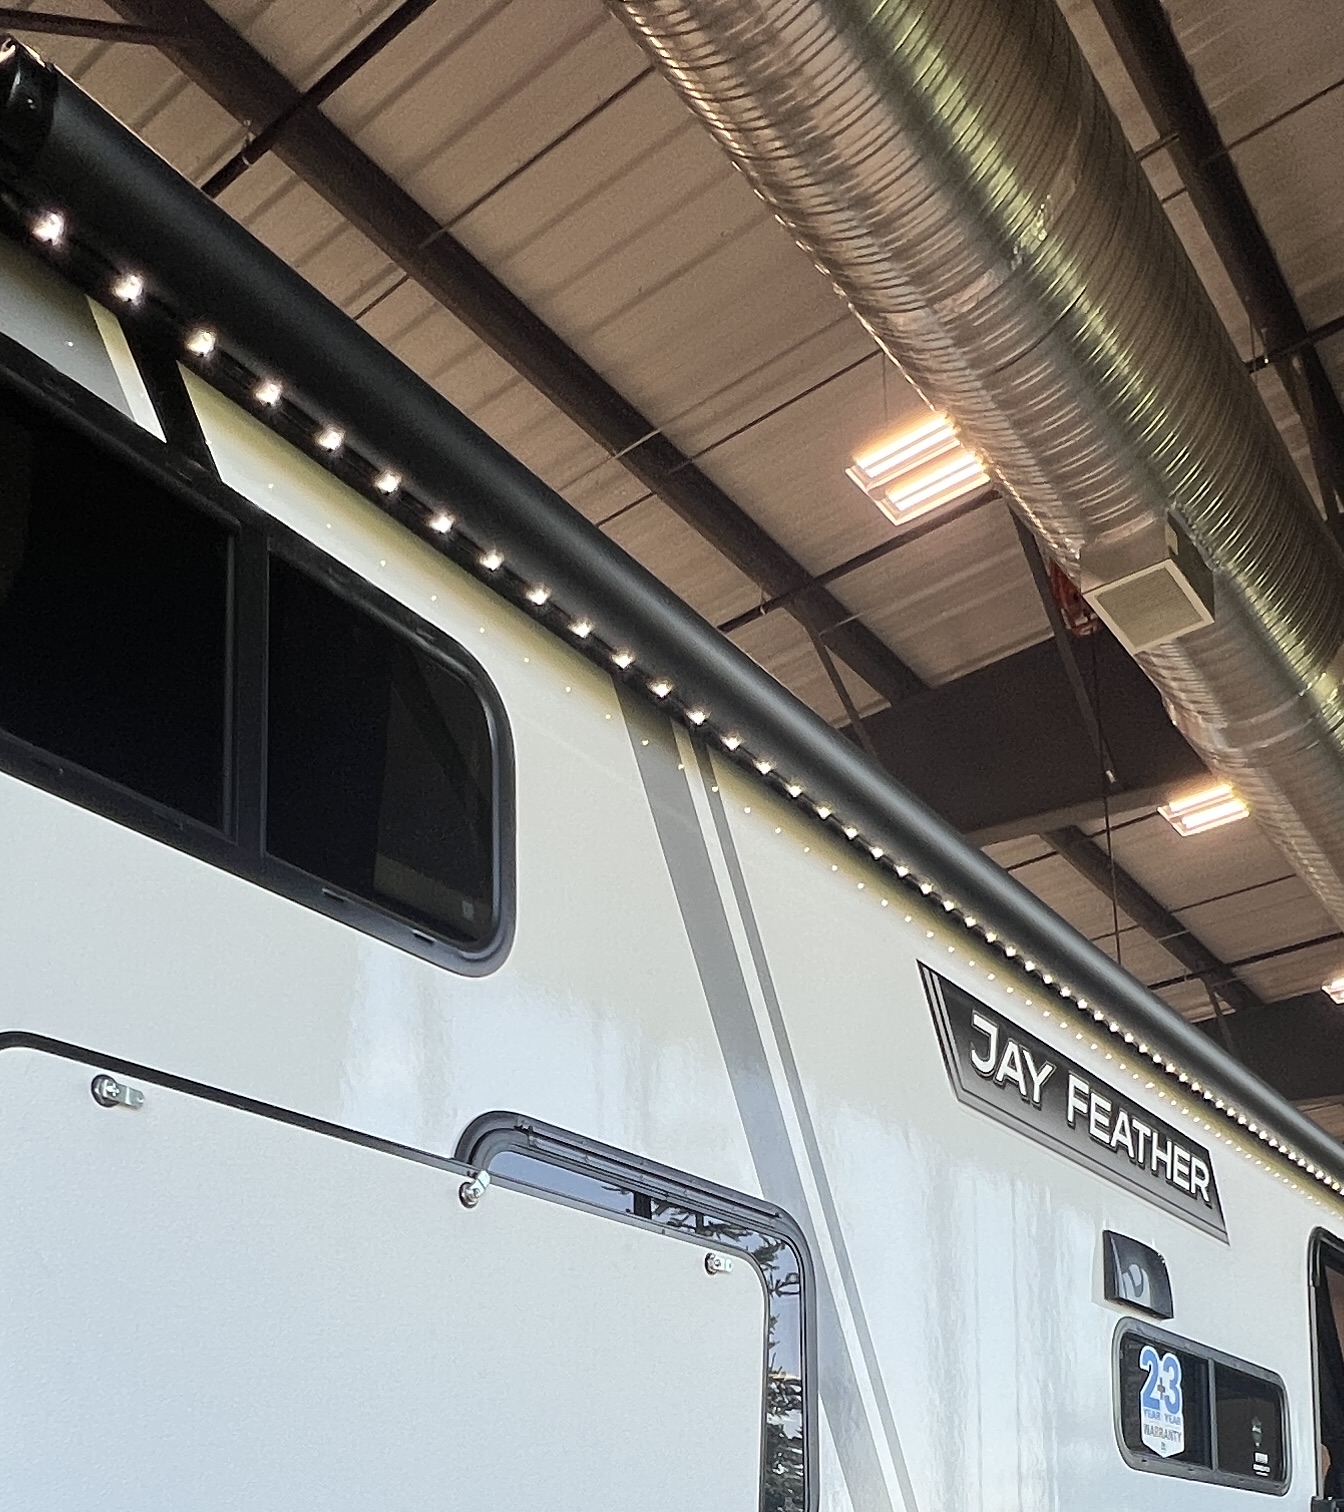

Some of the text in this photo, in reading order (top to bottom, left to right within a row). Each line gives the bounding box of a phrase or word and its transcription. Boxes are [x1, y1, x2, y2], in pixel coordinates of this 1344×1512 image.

[970, 1012, 1212, 1204] JAY FEATHER
[1144, 1408, 1181, 1426] YEAR YEAR
[1144, 1423, 1182, 1444] WARRANTY
